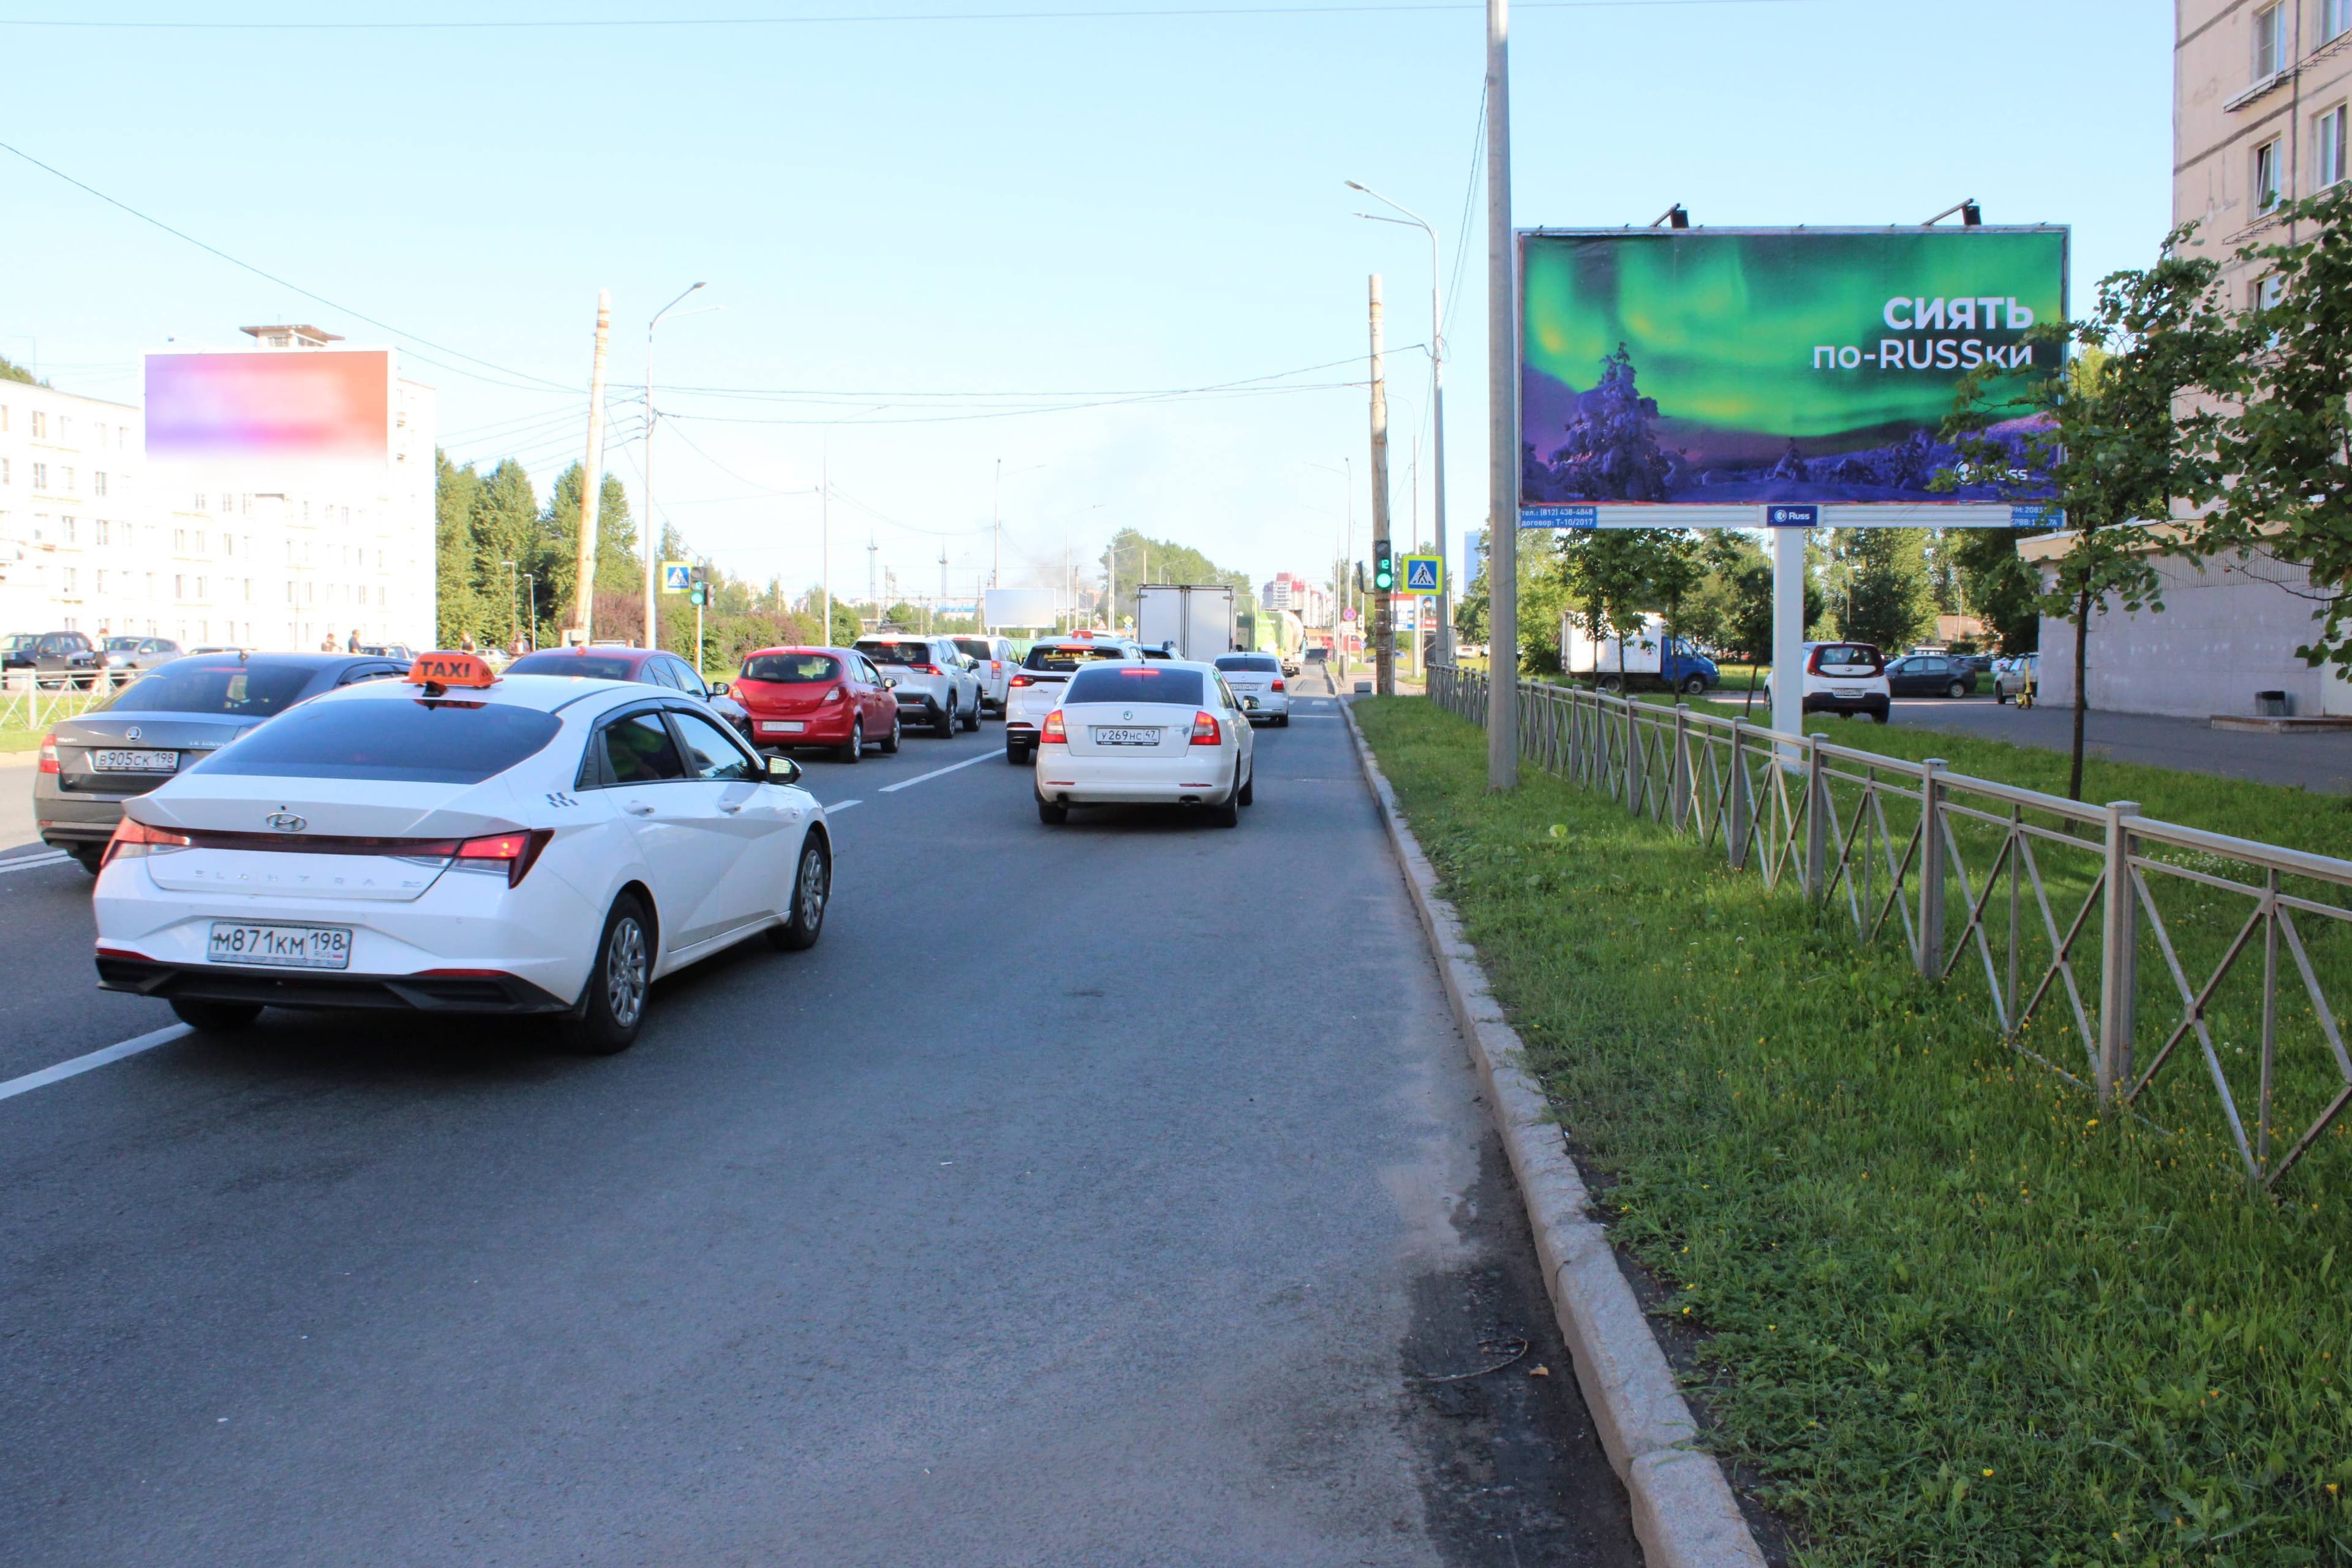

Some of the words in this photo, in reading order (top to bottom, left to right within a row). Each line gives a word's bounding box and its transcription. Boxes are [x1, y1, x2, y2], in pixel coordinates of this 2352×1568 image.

[1883, 296, 2034, 330] СИЯТЬ
[1814, 339, 2032, 369] по-RUSSки
[1540, 508, 1558, 517] (812)
[1789, 511, 1811, 520] Russ
[420, 661, 470, 677] TAXI
[1101, 730, 1142, 741] У269НС
[1145, 730, 1155, 739] 47
[100, 752, 151, 766] В905СК
[154, 752, 173, 763] 198
[216, 929, 305, 956] М871КМ
[311, 932, 343, 951] 198
